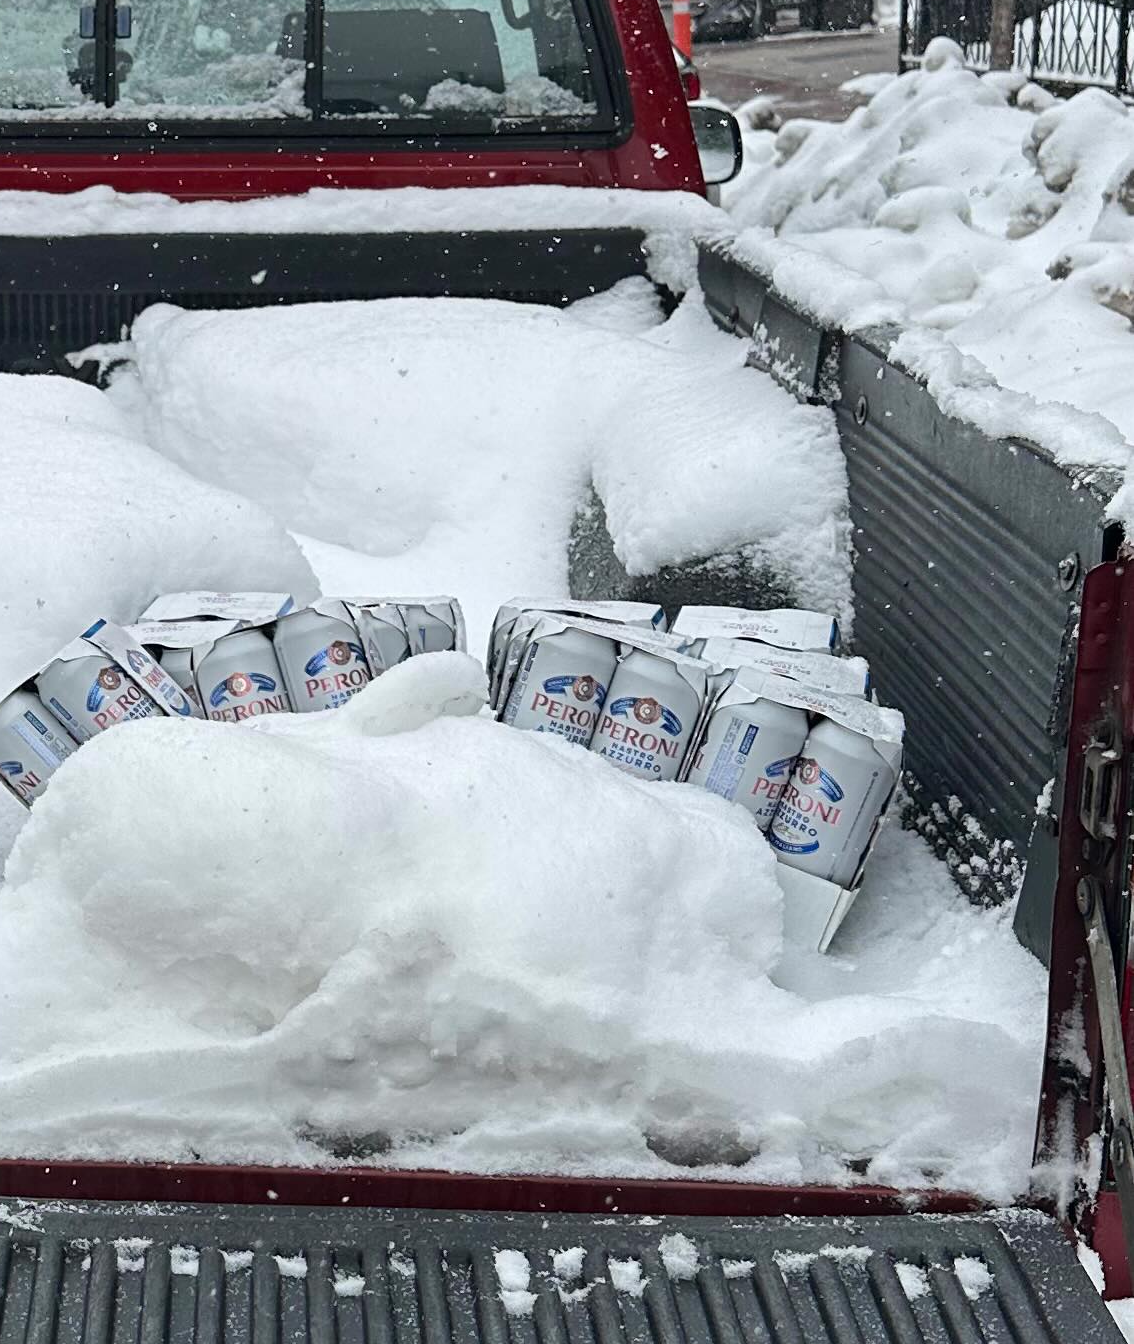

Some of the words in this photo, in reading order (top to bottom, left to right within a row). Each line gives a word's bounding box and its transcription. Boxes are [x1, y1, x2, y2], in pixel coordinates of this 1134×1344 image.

[305, 667, 370, 699] PERON
[92, 685, 142, 731] PERO
[599, 714, 680, 759] PERONI
[611, 742, 655, 762] NASTRO
[599, 746, 662, 774] AZZURRO
